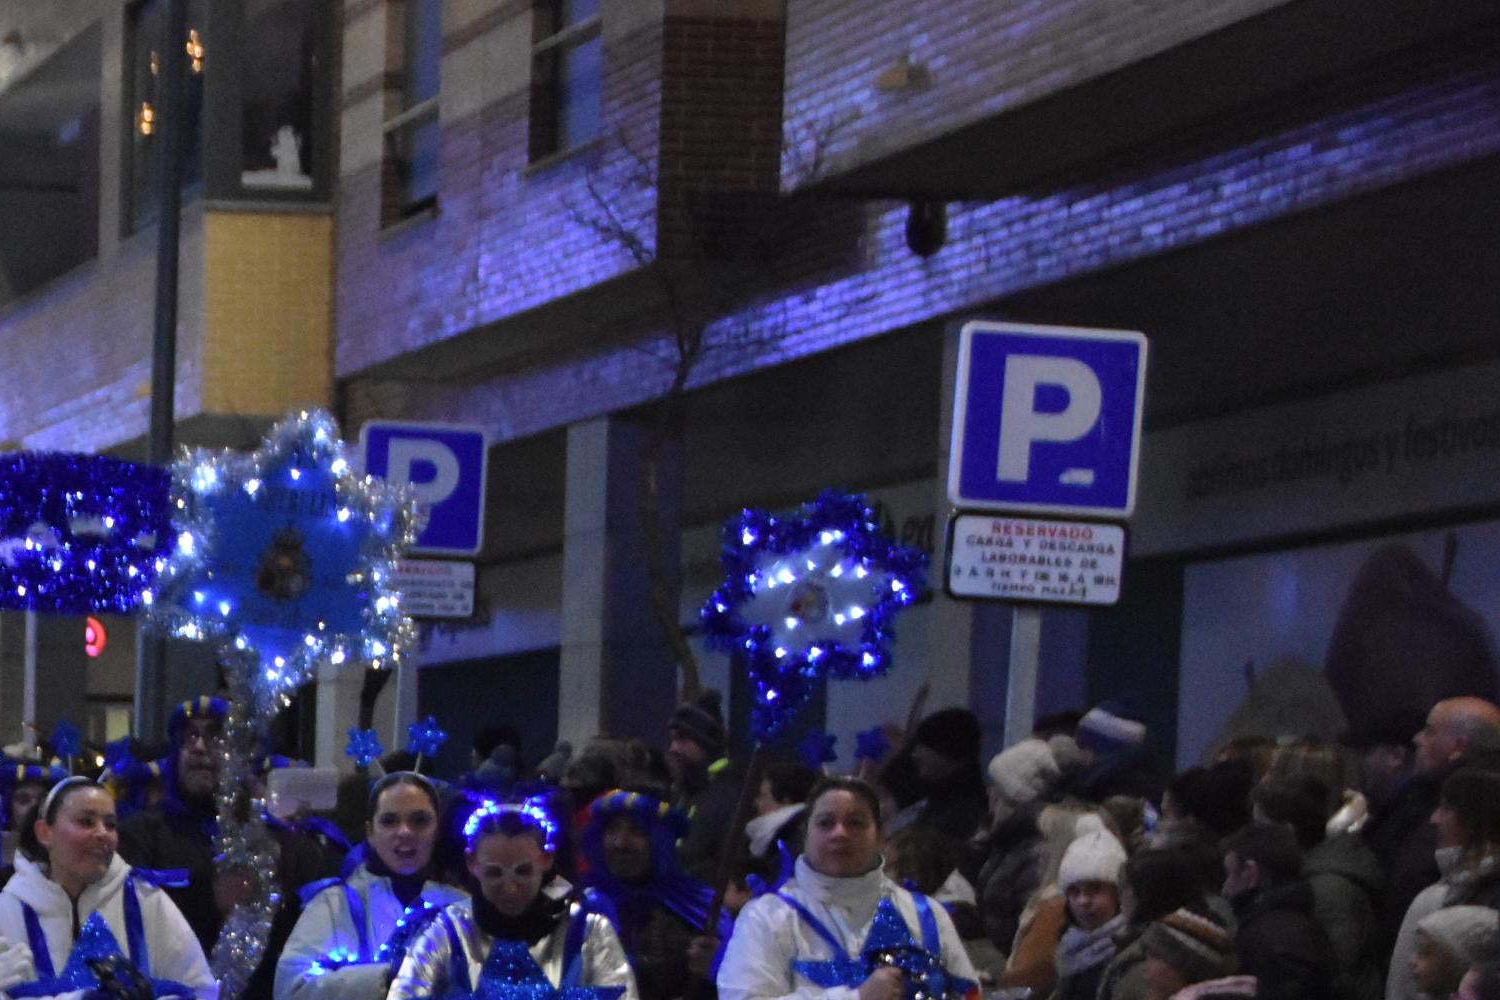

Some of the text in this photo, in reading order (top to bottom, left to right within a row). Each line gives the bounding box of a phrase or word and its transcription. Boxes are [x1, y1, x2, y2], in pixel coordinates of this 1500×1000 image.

[996, 353, 1102, 482] P
[386, 437, 460, 535] P
[992, 520, 1093, 540] RESERVADO
[966, 533, 1014, 548] CARGA
[1039, 540, 1115, 555] DESCARGA
[981, 551, 1073, 568] LABORABLES
